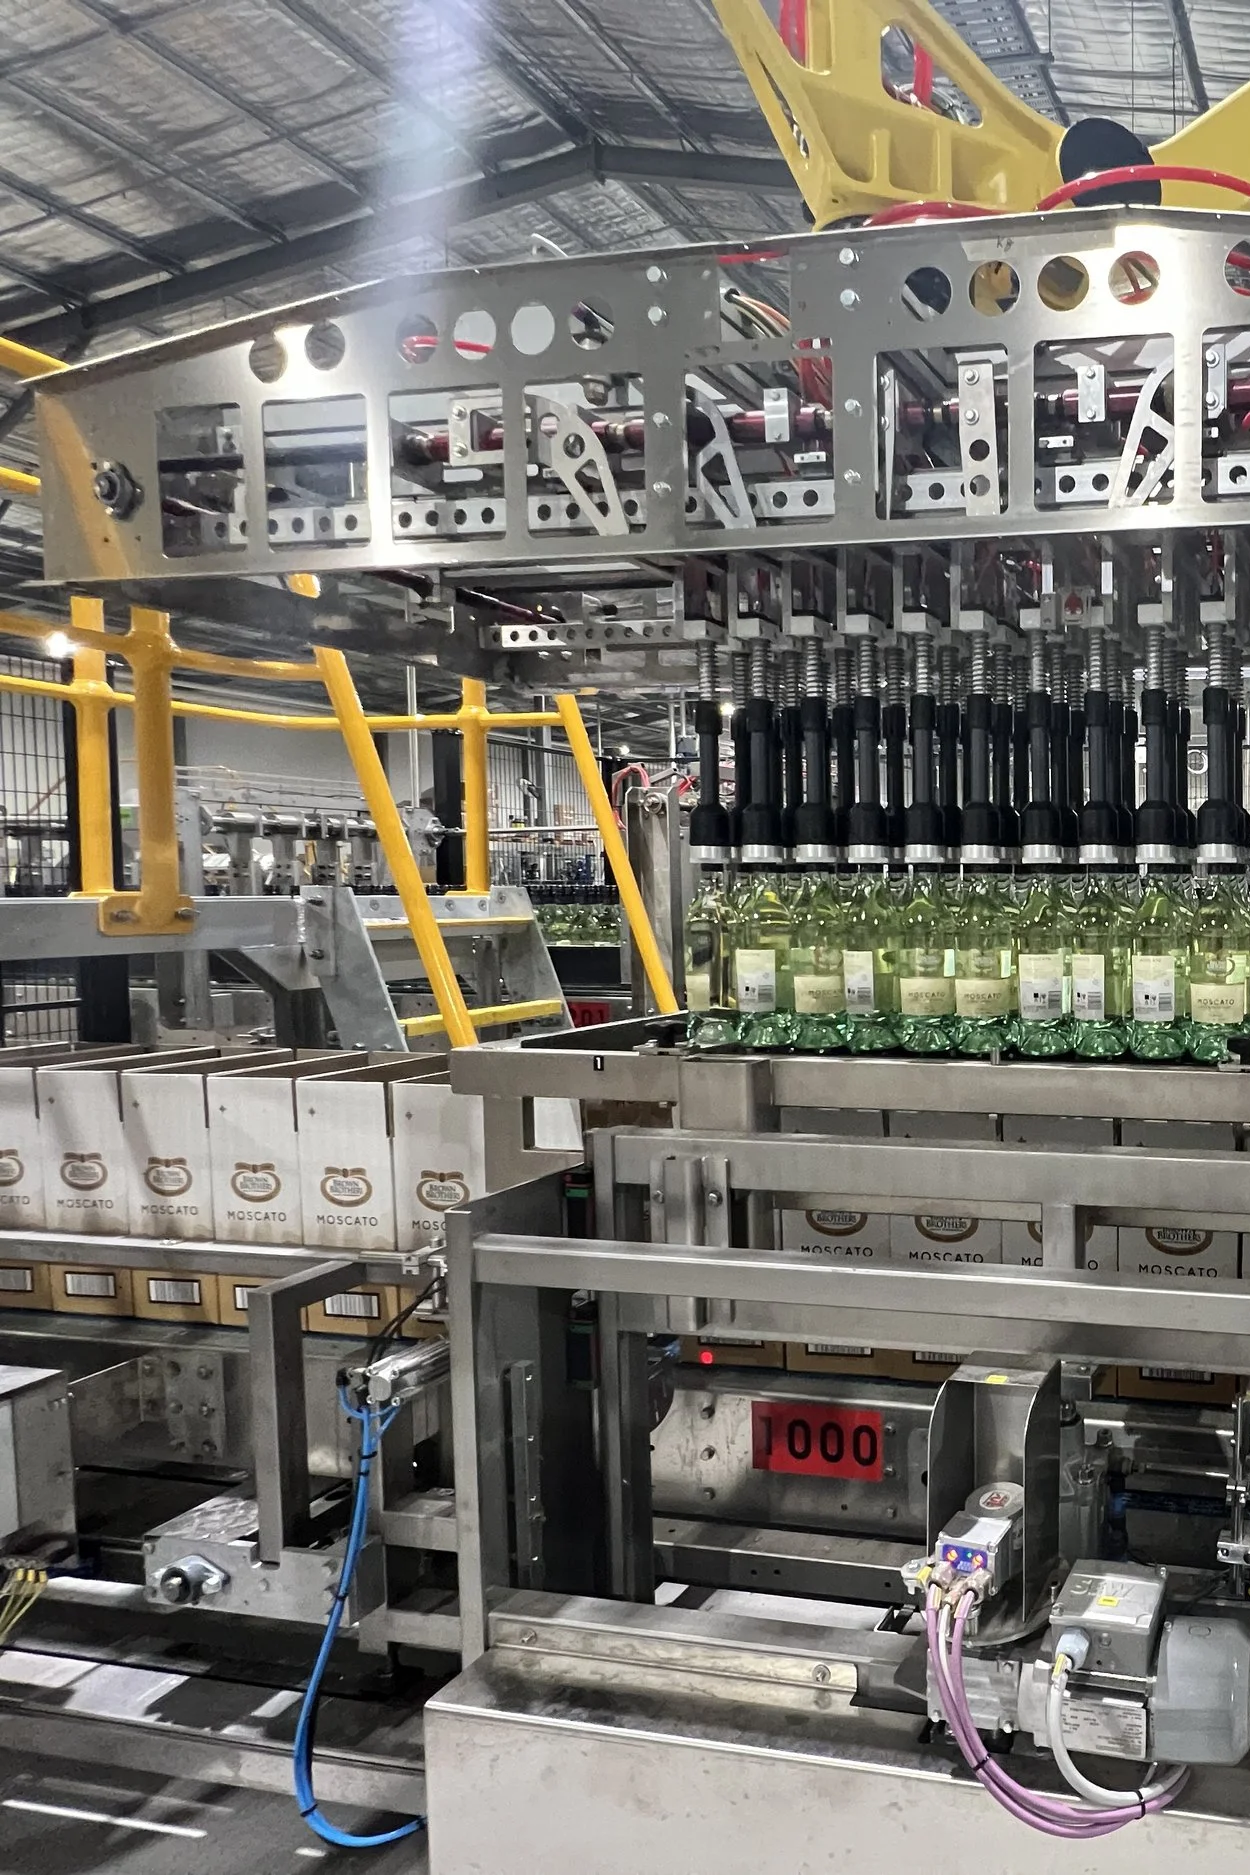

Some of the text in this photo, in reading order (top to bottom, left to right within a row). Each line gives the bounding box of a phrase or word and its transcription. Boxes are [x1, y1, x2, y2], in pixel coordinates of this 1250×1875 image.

[596, 1057, 601, 1070] 1
[57, 1199, 114, 1209] MOSCATO
[141, 1204, 199, 1216] MOSCATO
[227, 1210, 287, 1222] MOSCATO
[316, 1214, 378, 1227] MOSCATO
[909, 1251, 984, 1263] MOSCATO
[1138, 1263, 1218, 1278] MOSCATO
[758, 1415, 878, 1467] 1000
